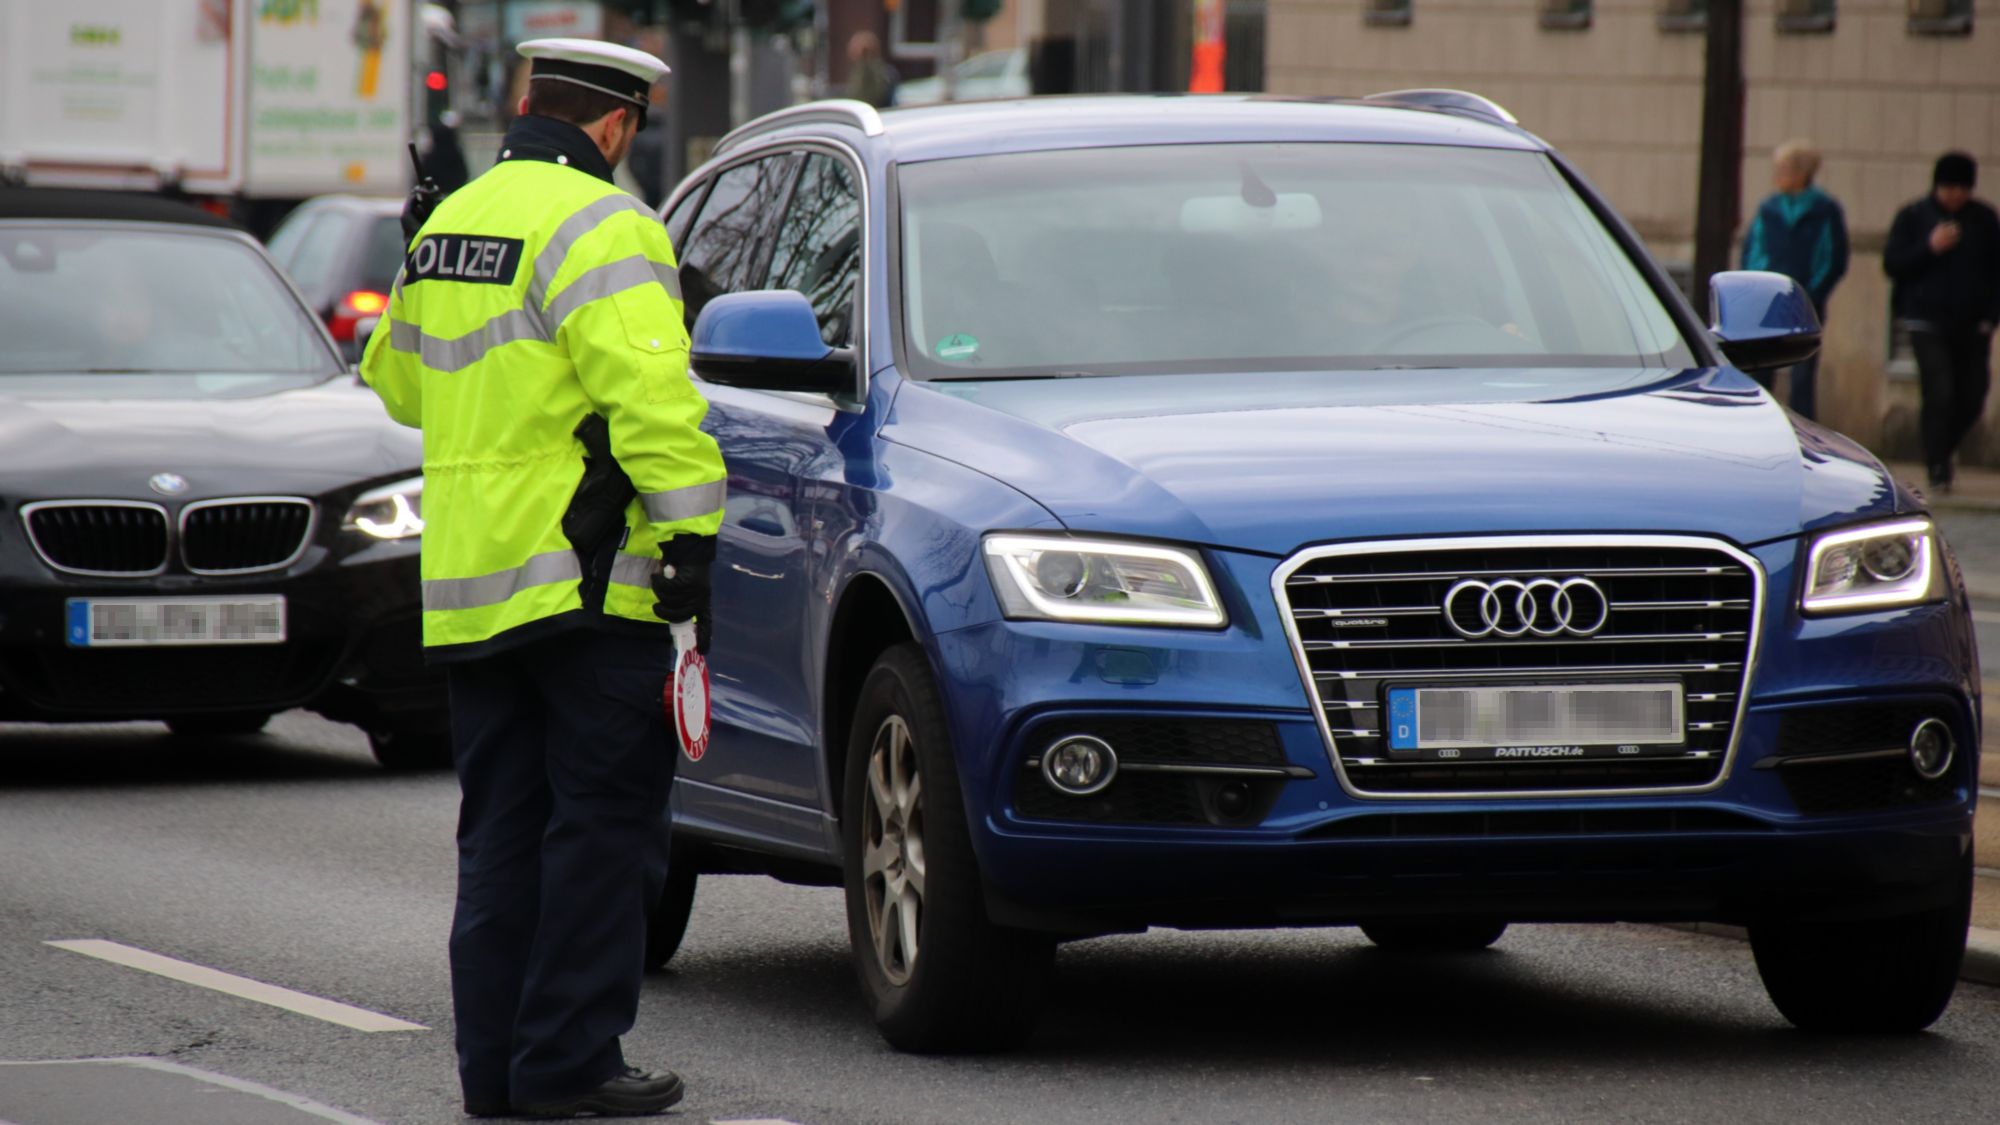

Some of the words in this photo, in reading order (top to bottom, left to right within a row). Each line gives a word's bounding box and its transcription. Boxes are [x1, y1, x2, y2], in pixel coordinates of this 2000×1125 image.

[411, 238, 508, 278] OLIZEI
[1399, 725, 1409, 738] D
[1495, 746, 1584, 757] PATTUSCH.de
